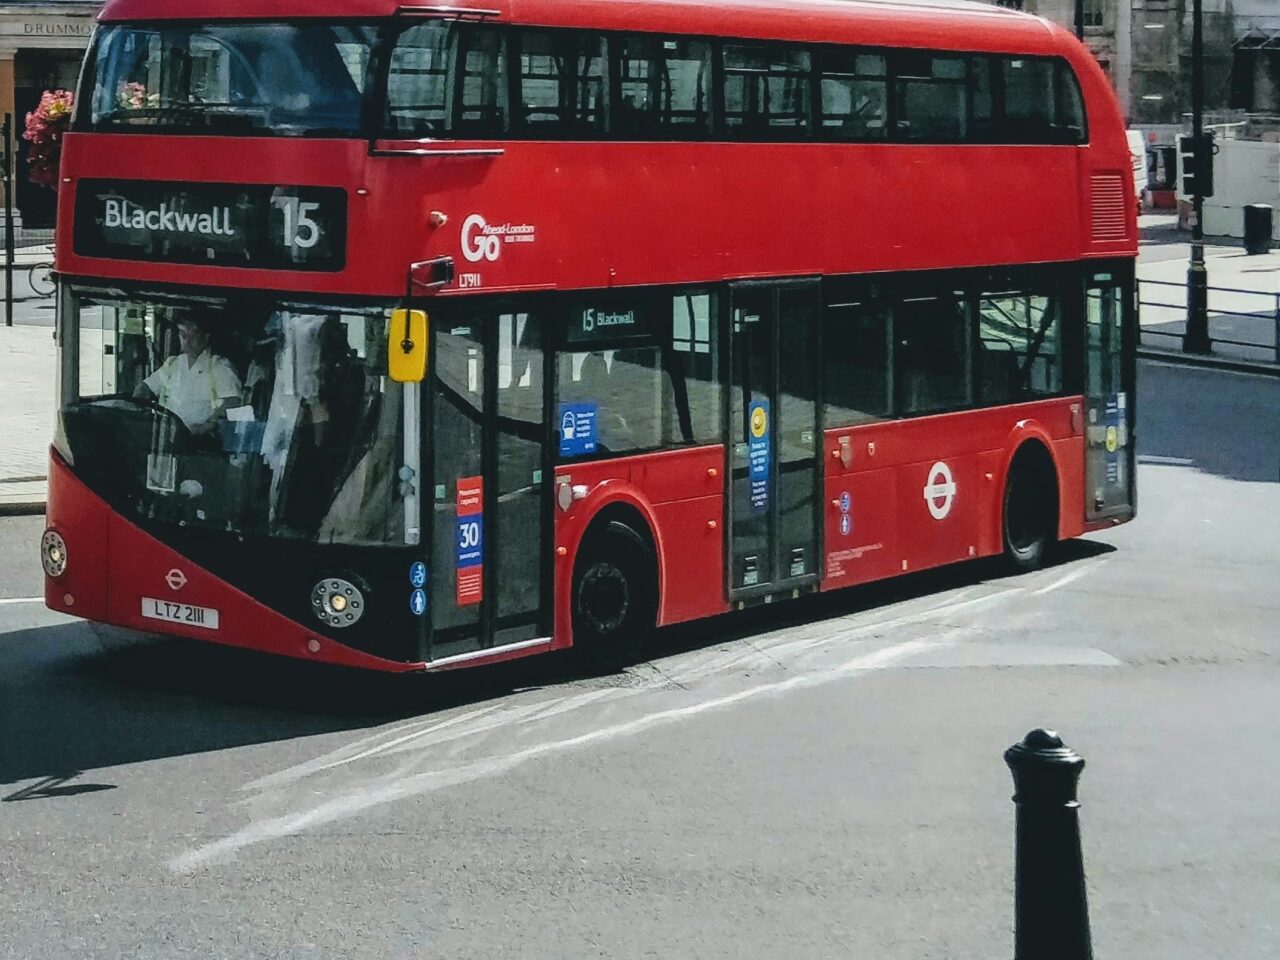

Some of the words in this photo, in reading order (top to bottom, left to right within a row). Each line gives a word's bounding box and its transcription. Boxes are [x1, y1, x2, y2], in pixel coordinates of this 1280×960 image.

[105, 199, 235, 236] Blackwall
[279, 202, 320, 248] 15
[461, 213, 500, 262] Go
[459, 273, 481, 288] LT911
[583, 308, 594, 331] 15
[597, 310, 635, 326] Blackwall
[459, 522, 479, 548] 30
[154, 600, 181, 620] LTZ
[185, 606, 205, 624] 2111
